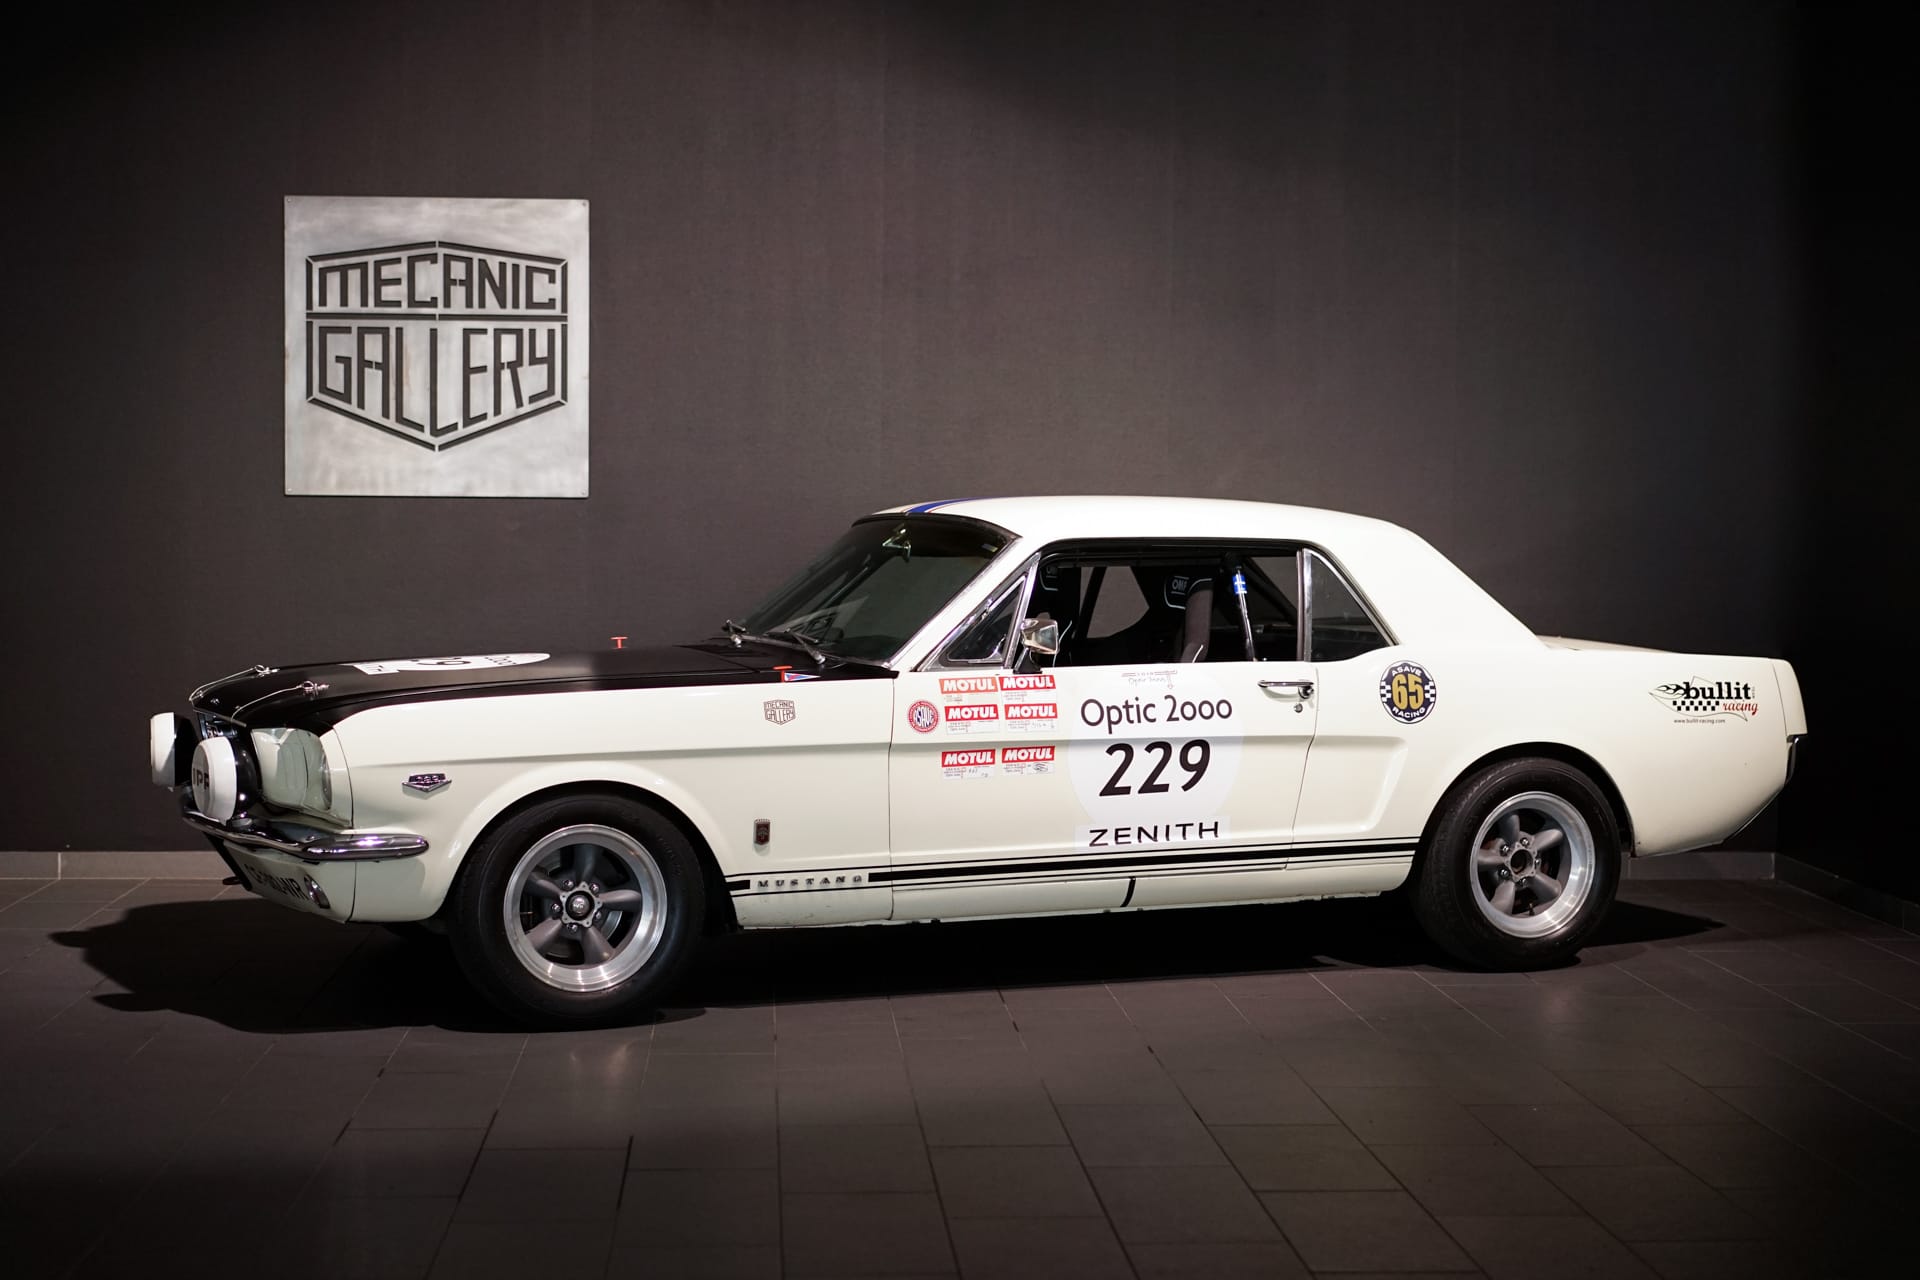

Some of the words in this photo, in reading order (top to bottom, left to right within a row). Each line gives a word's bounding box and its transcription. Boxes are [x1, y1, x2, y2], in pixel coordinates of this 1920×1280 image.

[318, 252, 556, 310] MECANIC
[318, 326, 556, 438] GALLERY
[1391, 665, 1422, 677] ASAVE
[943, 678, 995, 692] MOTUL
[1003, 676, 1054, 690] MOTUL
[1391, 673, 1425, 710] 65
[1683, 681, 1751, 700] bullit
[948, 706, 997, 720] MOTUL
[1007, 705, 1056, 718] MOTUL
[1081, 697, 1156, 735] Optic
[1165, 695, 1233, 722] 2000
[1392, 706, 1426, 719] RACING
[1722, 700, 1759, 716] racing
[944, 751, 994, 765] MOTUL
[1004, 747, 1053, 761] MOTUL
[1099, 739, 1211, 797] 229
[1089, 821, 1220, 847] ZENITH
[757, 875, 863, 889] MUSTANG
